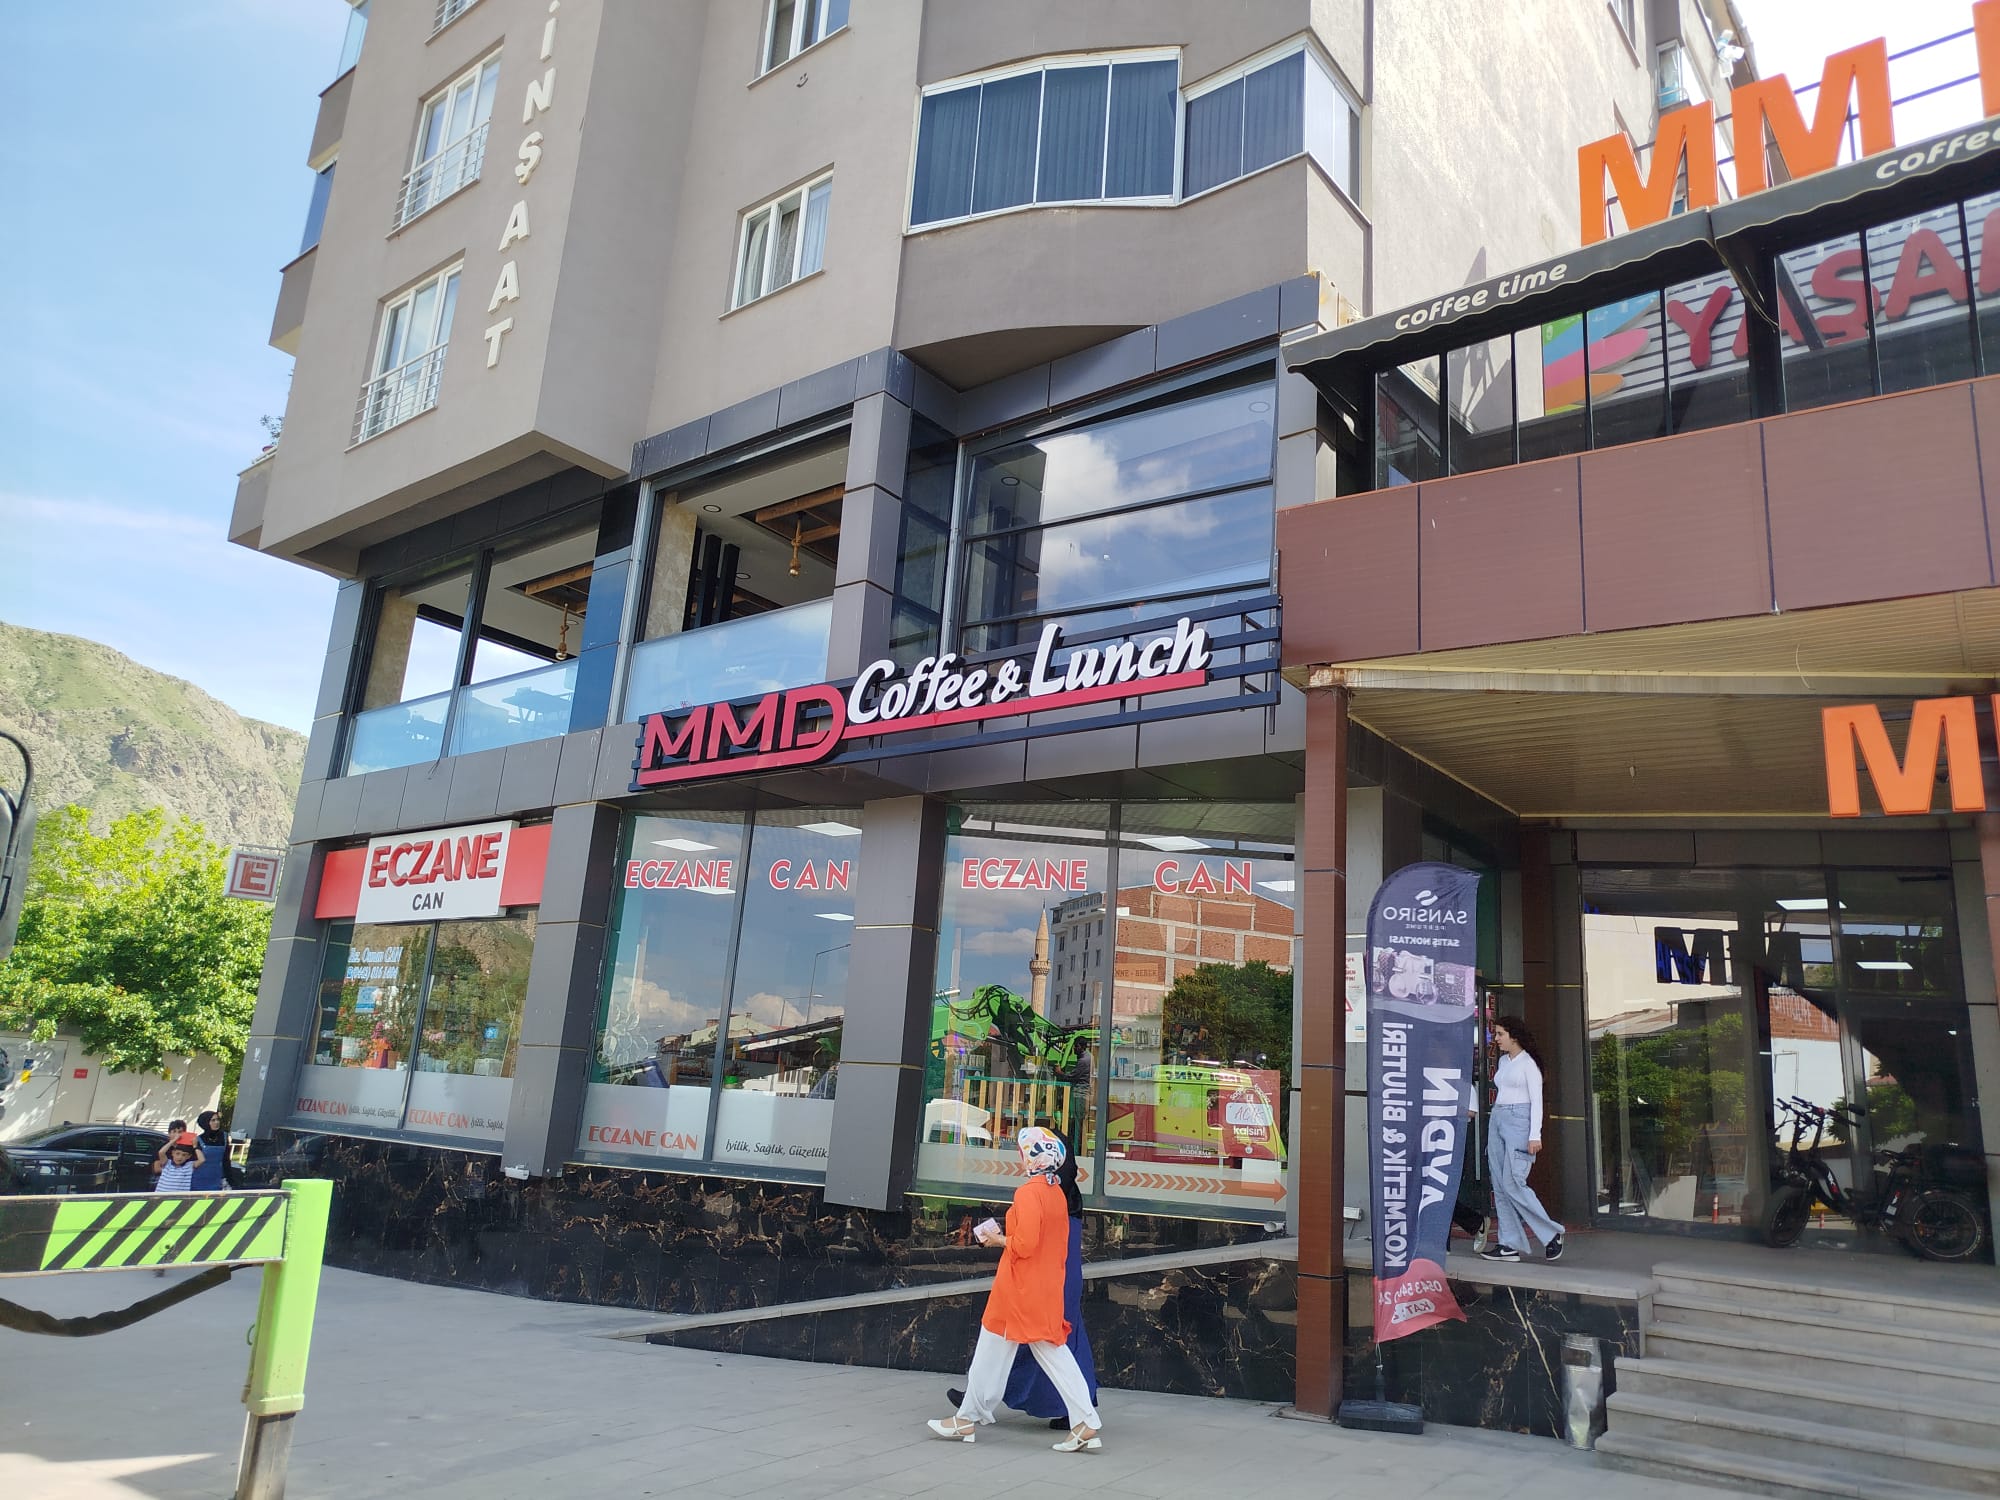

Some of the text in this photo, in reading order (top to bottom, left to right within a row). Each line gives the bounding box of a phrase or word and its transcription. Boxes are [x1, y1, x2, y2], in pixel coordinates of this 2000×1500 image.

[1577, 0, 2000, 246] MM
[1393, 260, 1568, 332] coffee time
[640, 616, 1212, 782] MMD Coffee & Lunch
[1821, 694, 2000, 818] M
[368, 831, 503, 889] ECZANE
[624, 857, 852, 891] ECZANE CAN
[961, 857, 1253, 895] ECZANE CAN
[411, 891, 445, 912] CAN
[329, 1100, 348, 1116] CAN
[408, 1108, 446, 1126] ECZANE
[447, 1112, 469, 1129] CAN
[588, 1125, 657, 1147] ECZANE
[660, 1131, 698, 1151] CAN
